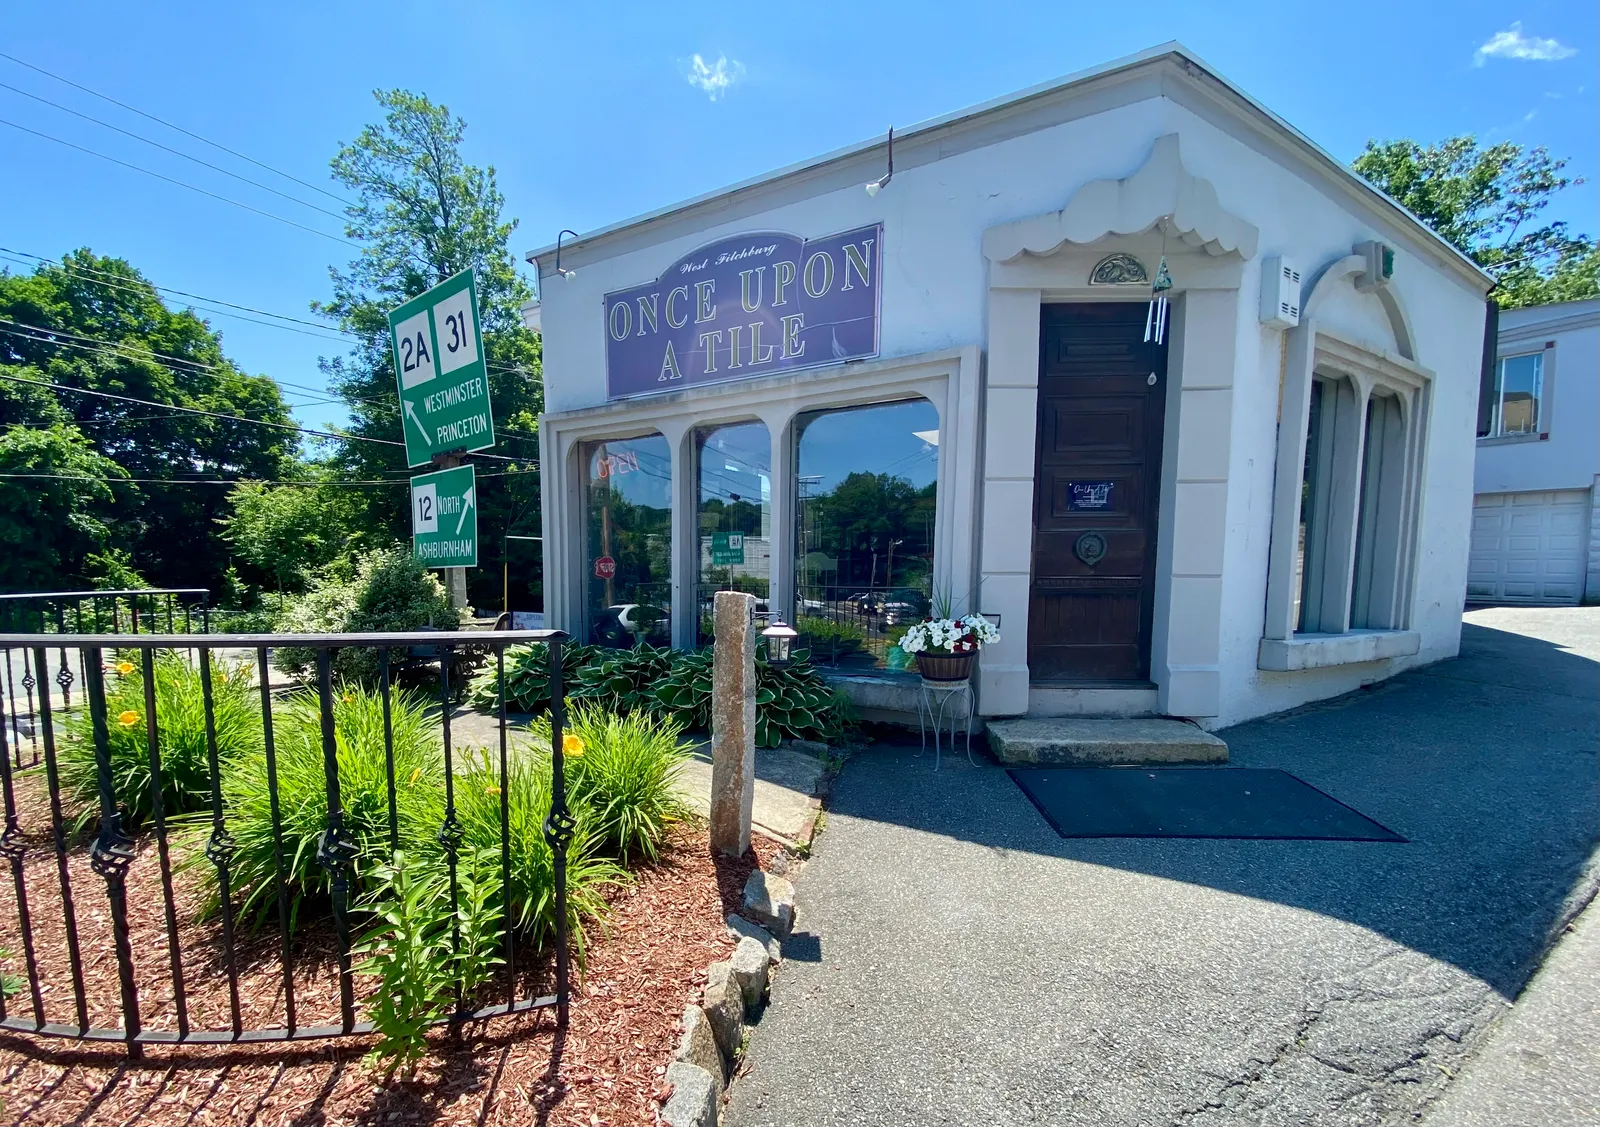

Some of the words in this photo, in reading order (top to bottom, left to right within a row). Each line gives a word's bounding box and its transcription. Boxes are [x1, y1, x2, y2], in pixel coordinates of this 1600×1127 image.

[680, 258, 709, 275] West
[715, 243, 779, 266] Fitchburg
[609, 279, 717, 342] ONCE
[739, 239, 875, 313] UPON
[445, 310, 467, 353] 31
[658, 340, 682, 382] A
[700, 313, 806, 374] TILE
[401, 331, 430, 373] 2A
[424, 378, 483, 414] WESTMINSTER
[437, 413, 487, 445] PRINCETON
[597, 451, 640, 478] OPEN
[418, 496, 432, 522] 12
[437, 496, 461, 515] NORTH
[418, 539, 472, 559] ASHBURNHAM
